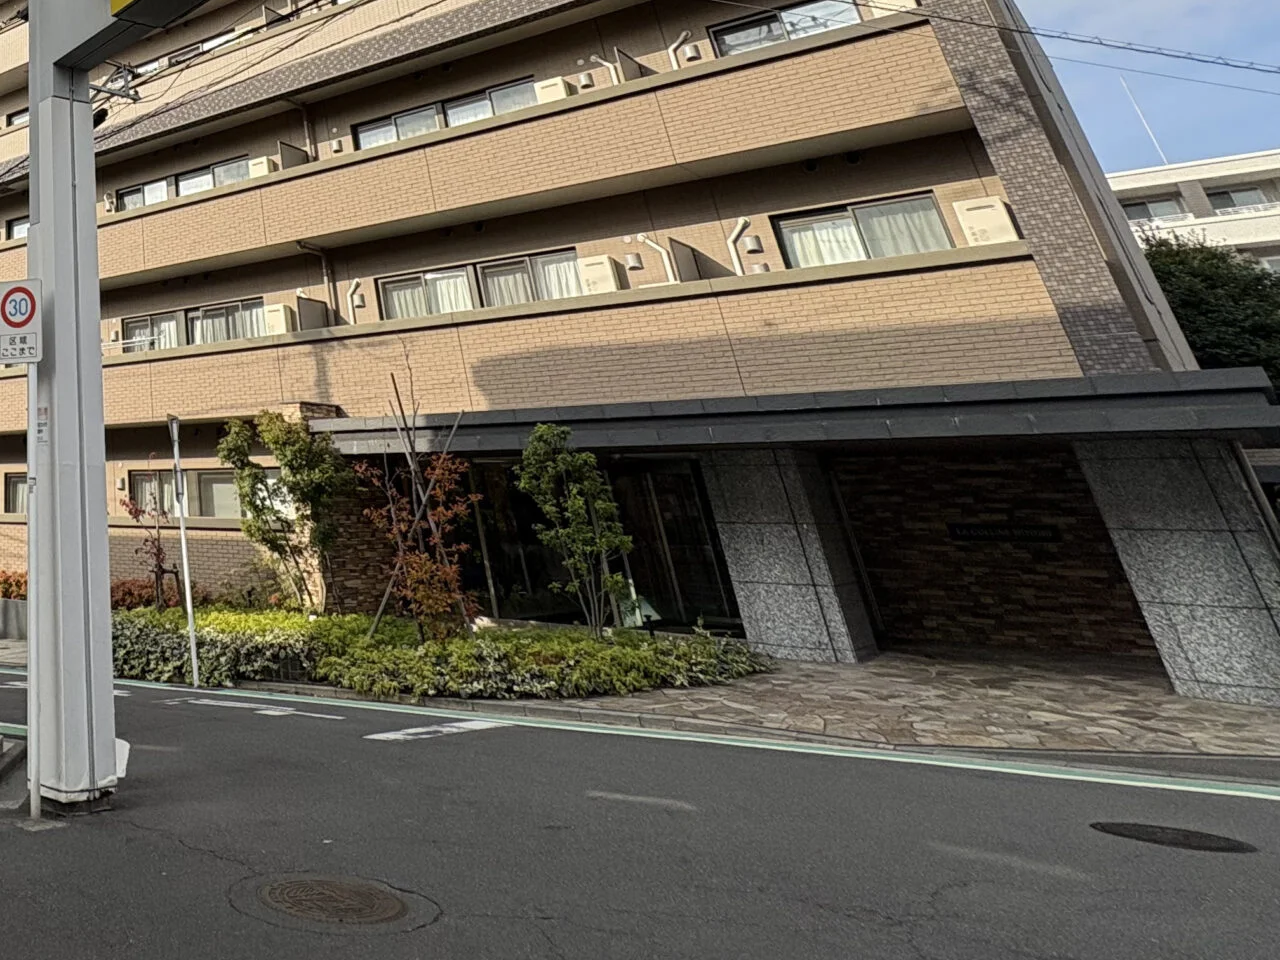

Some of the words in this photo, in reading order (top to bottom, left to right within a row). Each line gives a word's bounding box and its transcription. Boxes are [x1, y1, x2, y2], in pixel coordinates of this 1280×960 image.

[8, 297, 28, 317] 30
[1, 346, 35, 357] ここまで
